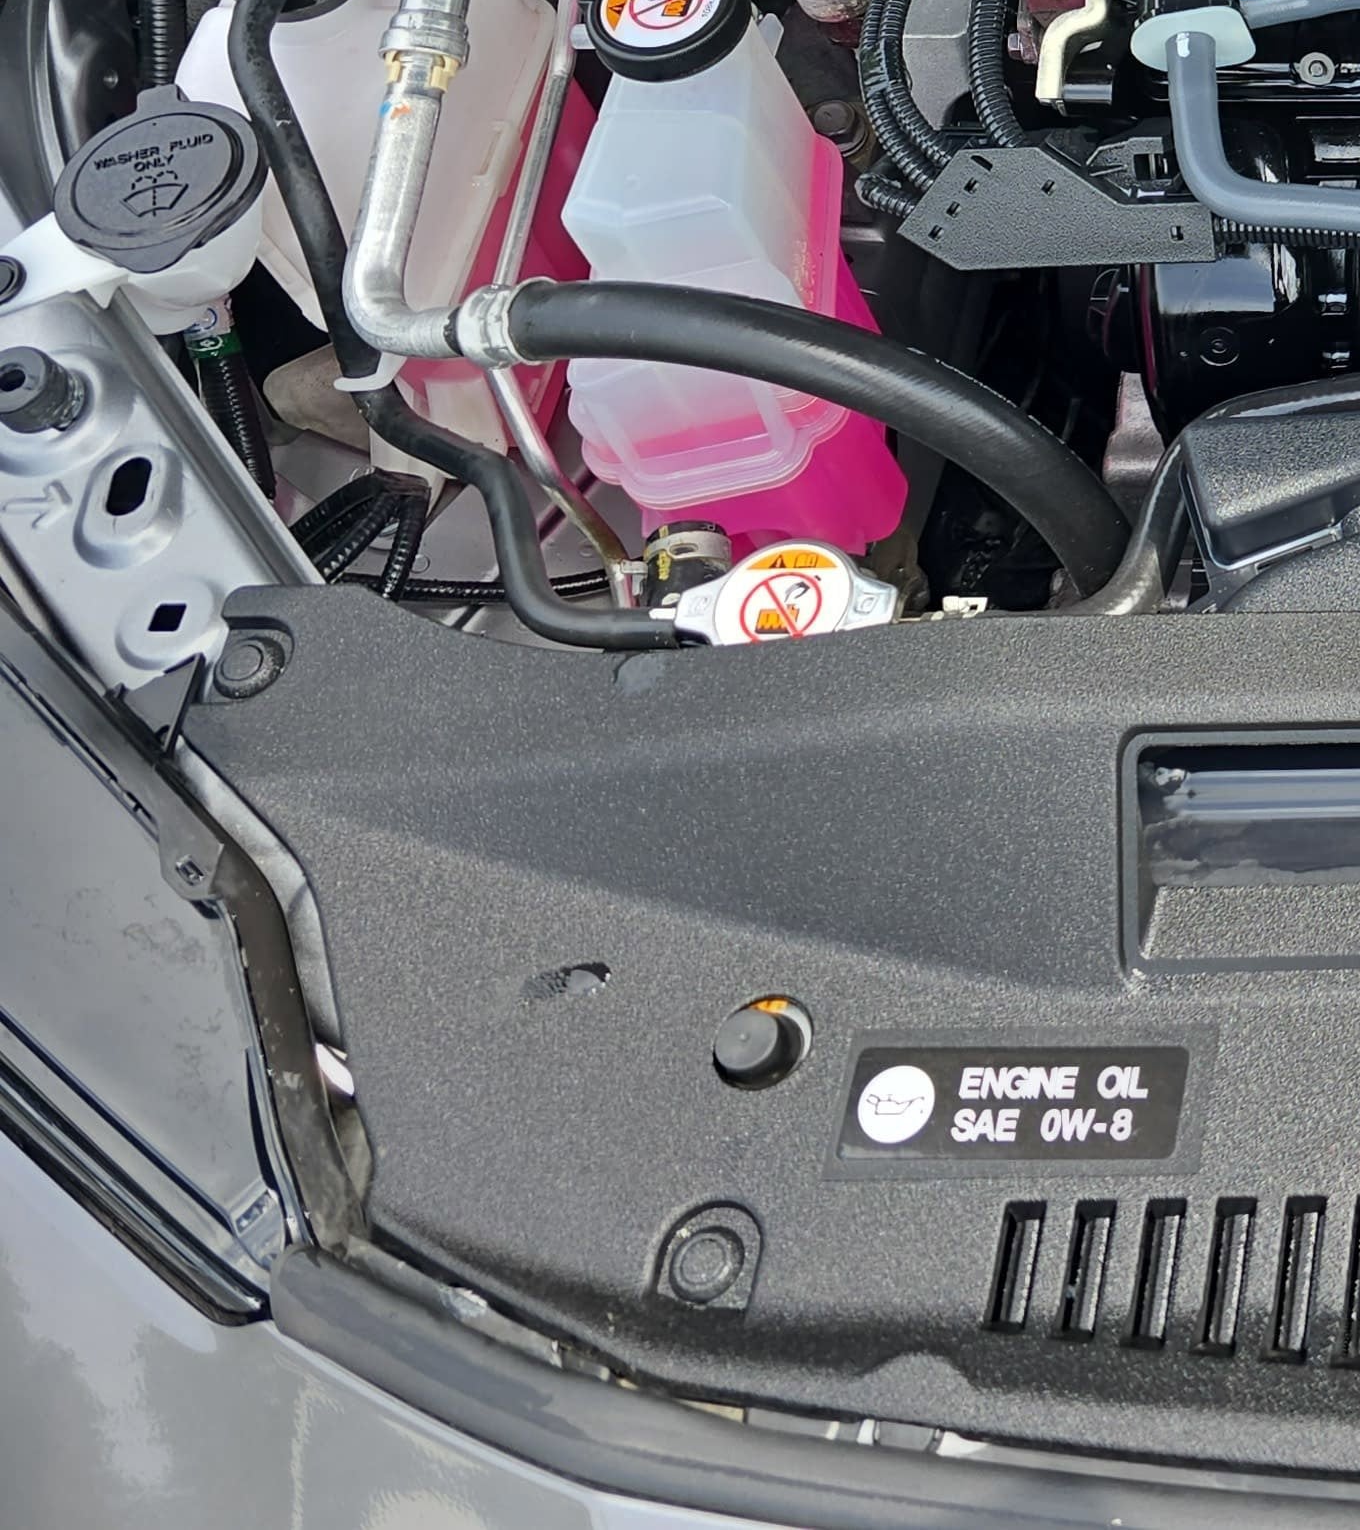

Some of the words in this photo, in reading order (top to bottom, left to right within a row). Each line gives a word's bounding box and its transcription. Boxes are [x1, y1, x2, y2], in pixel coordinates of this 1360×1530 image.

[93, 146, 161, 172] WASHER
[169, 133, 214, 153] FLUID
[134, 154, 175, 173] ONLY
[958, 1065, 1080, 1101] ENGINE
[1097, 1065, 1149, 1100] OIL
[951, 1108, 1020, 1143] SAE
[1040, 1108, 1134, 1143] 0W-8
